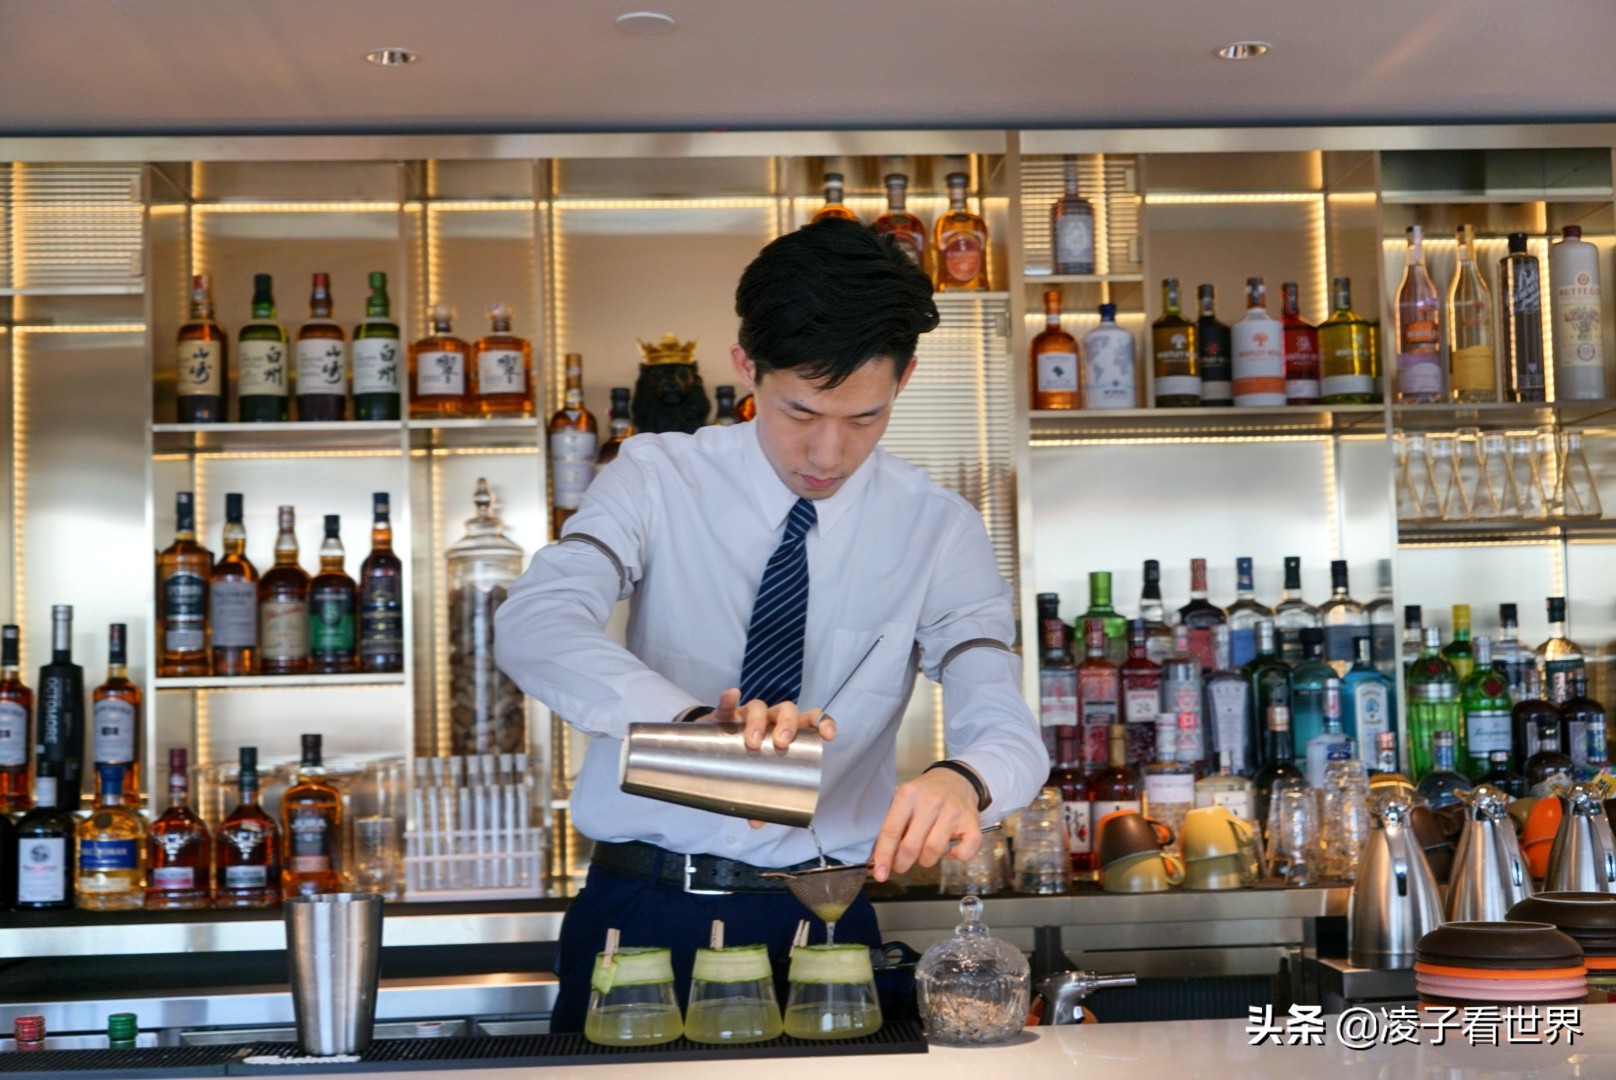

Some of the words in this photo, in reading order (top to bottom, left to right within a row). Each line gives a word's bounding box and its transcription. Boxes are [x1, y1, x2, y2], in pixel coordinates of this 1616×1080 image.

[264, 345, 282, 387] 白州
[378, 343, 397, 385] 白州
[291, 818, 327, 829] JURA
